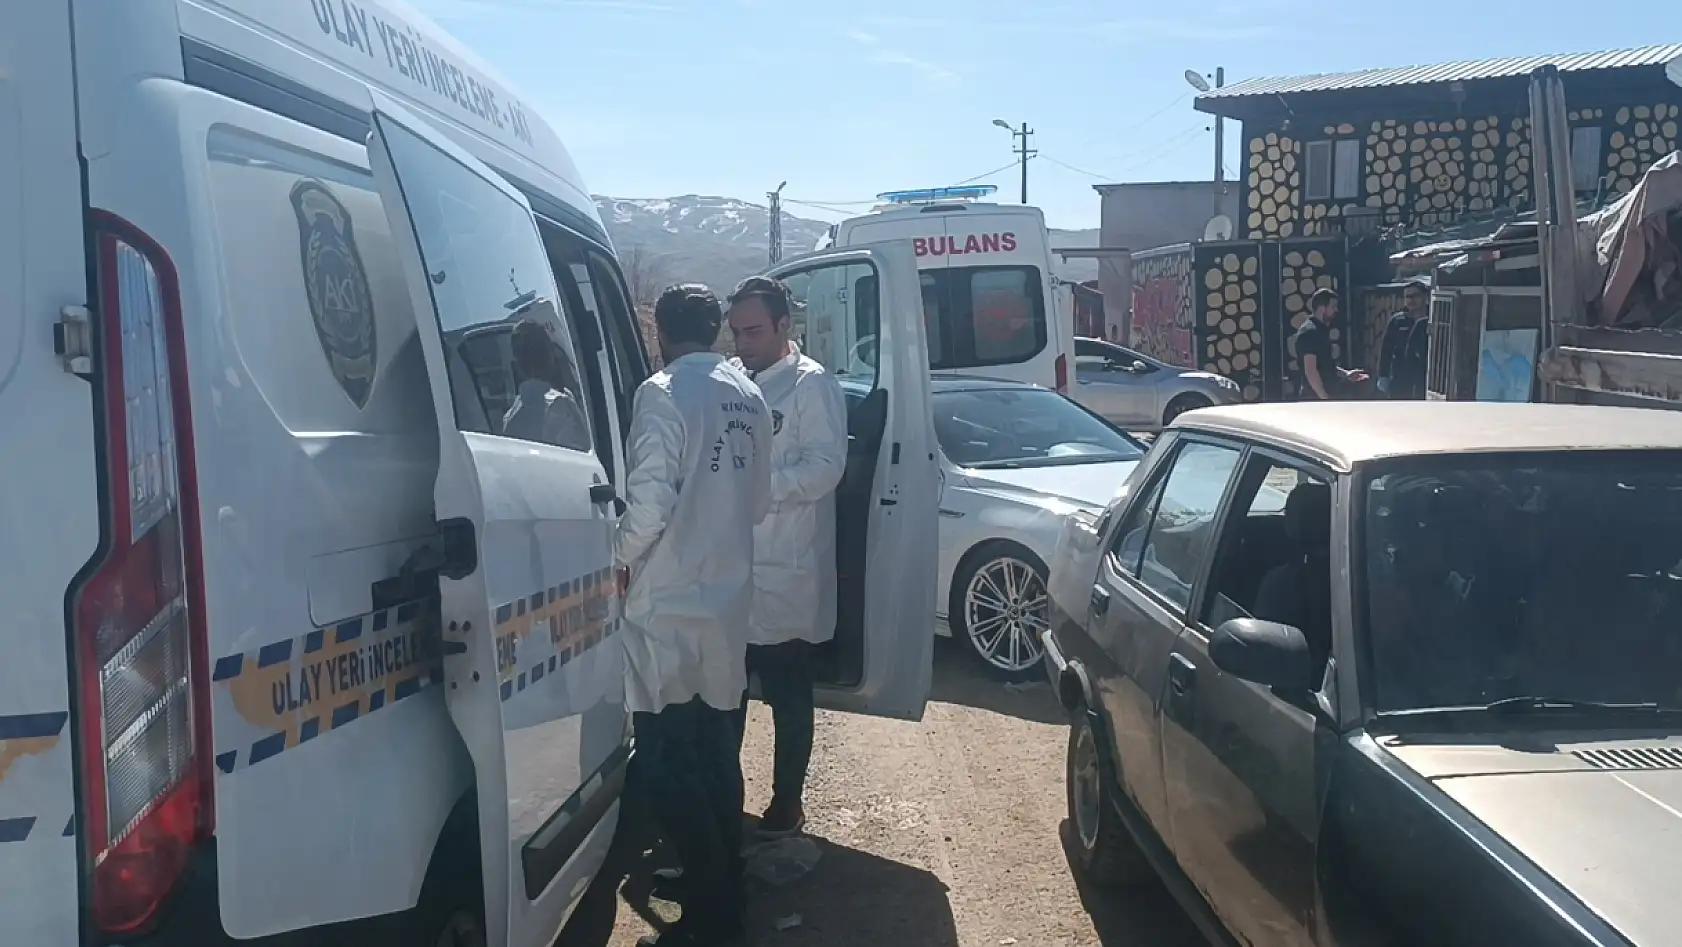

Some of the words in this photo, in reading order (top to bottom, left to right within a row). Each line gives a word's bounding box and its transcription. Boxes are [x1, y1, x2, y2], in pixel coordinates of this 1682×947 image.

[311, 0, 374, 58] OLAY
[372, 16, 428, 87] YERİ
[416, 32, 504, 130] İNCELEME
[912, 231, 1017, 257] BULANS
[710, 435, 725, 473] OLAY
[325, 647, 367, 695] YERİ
